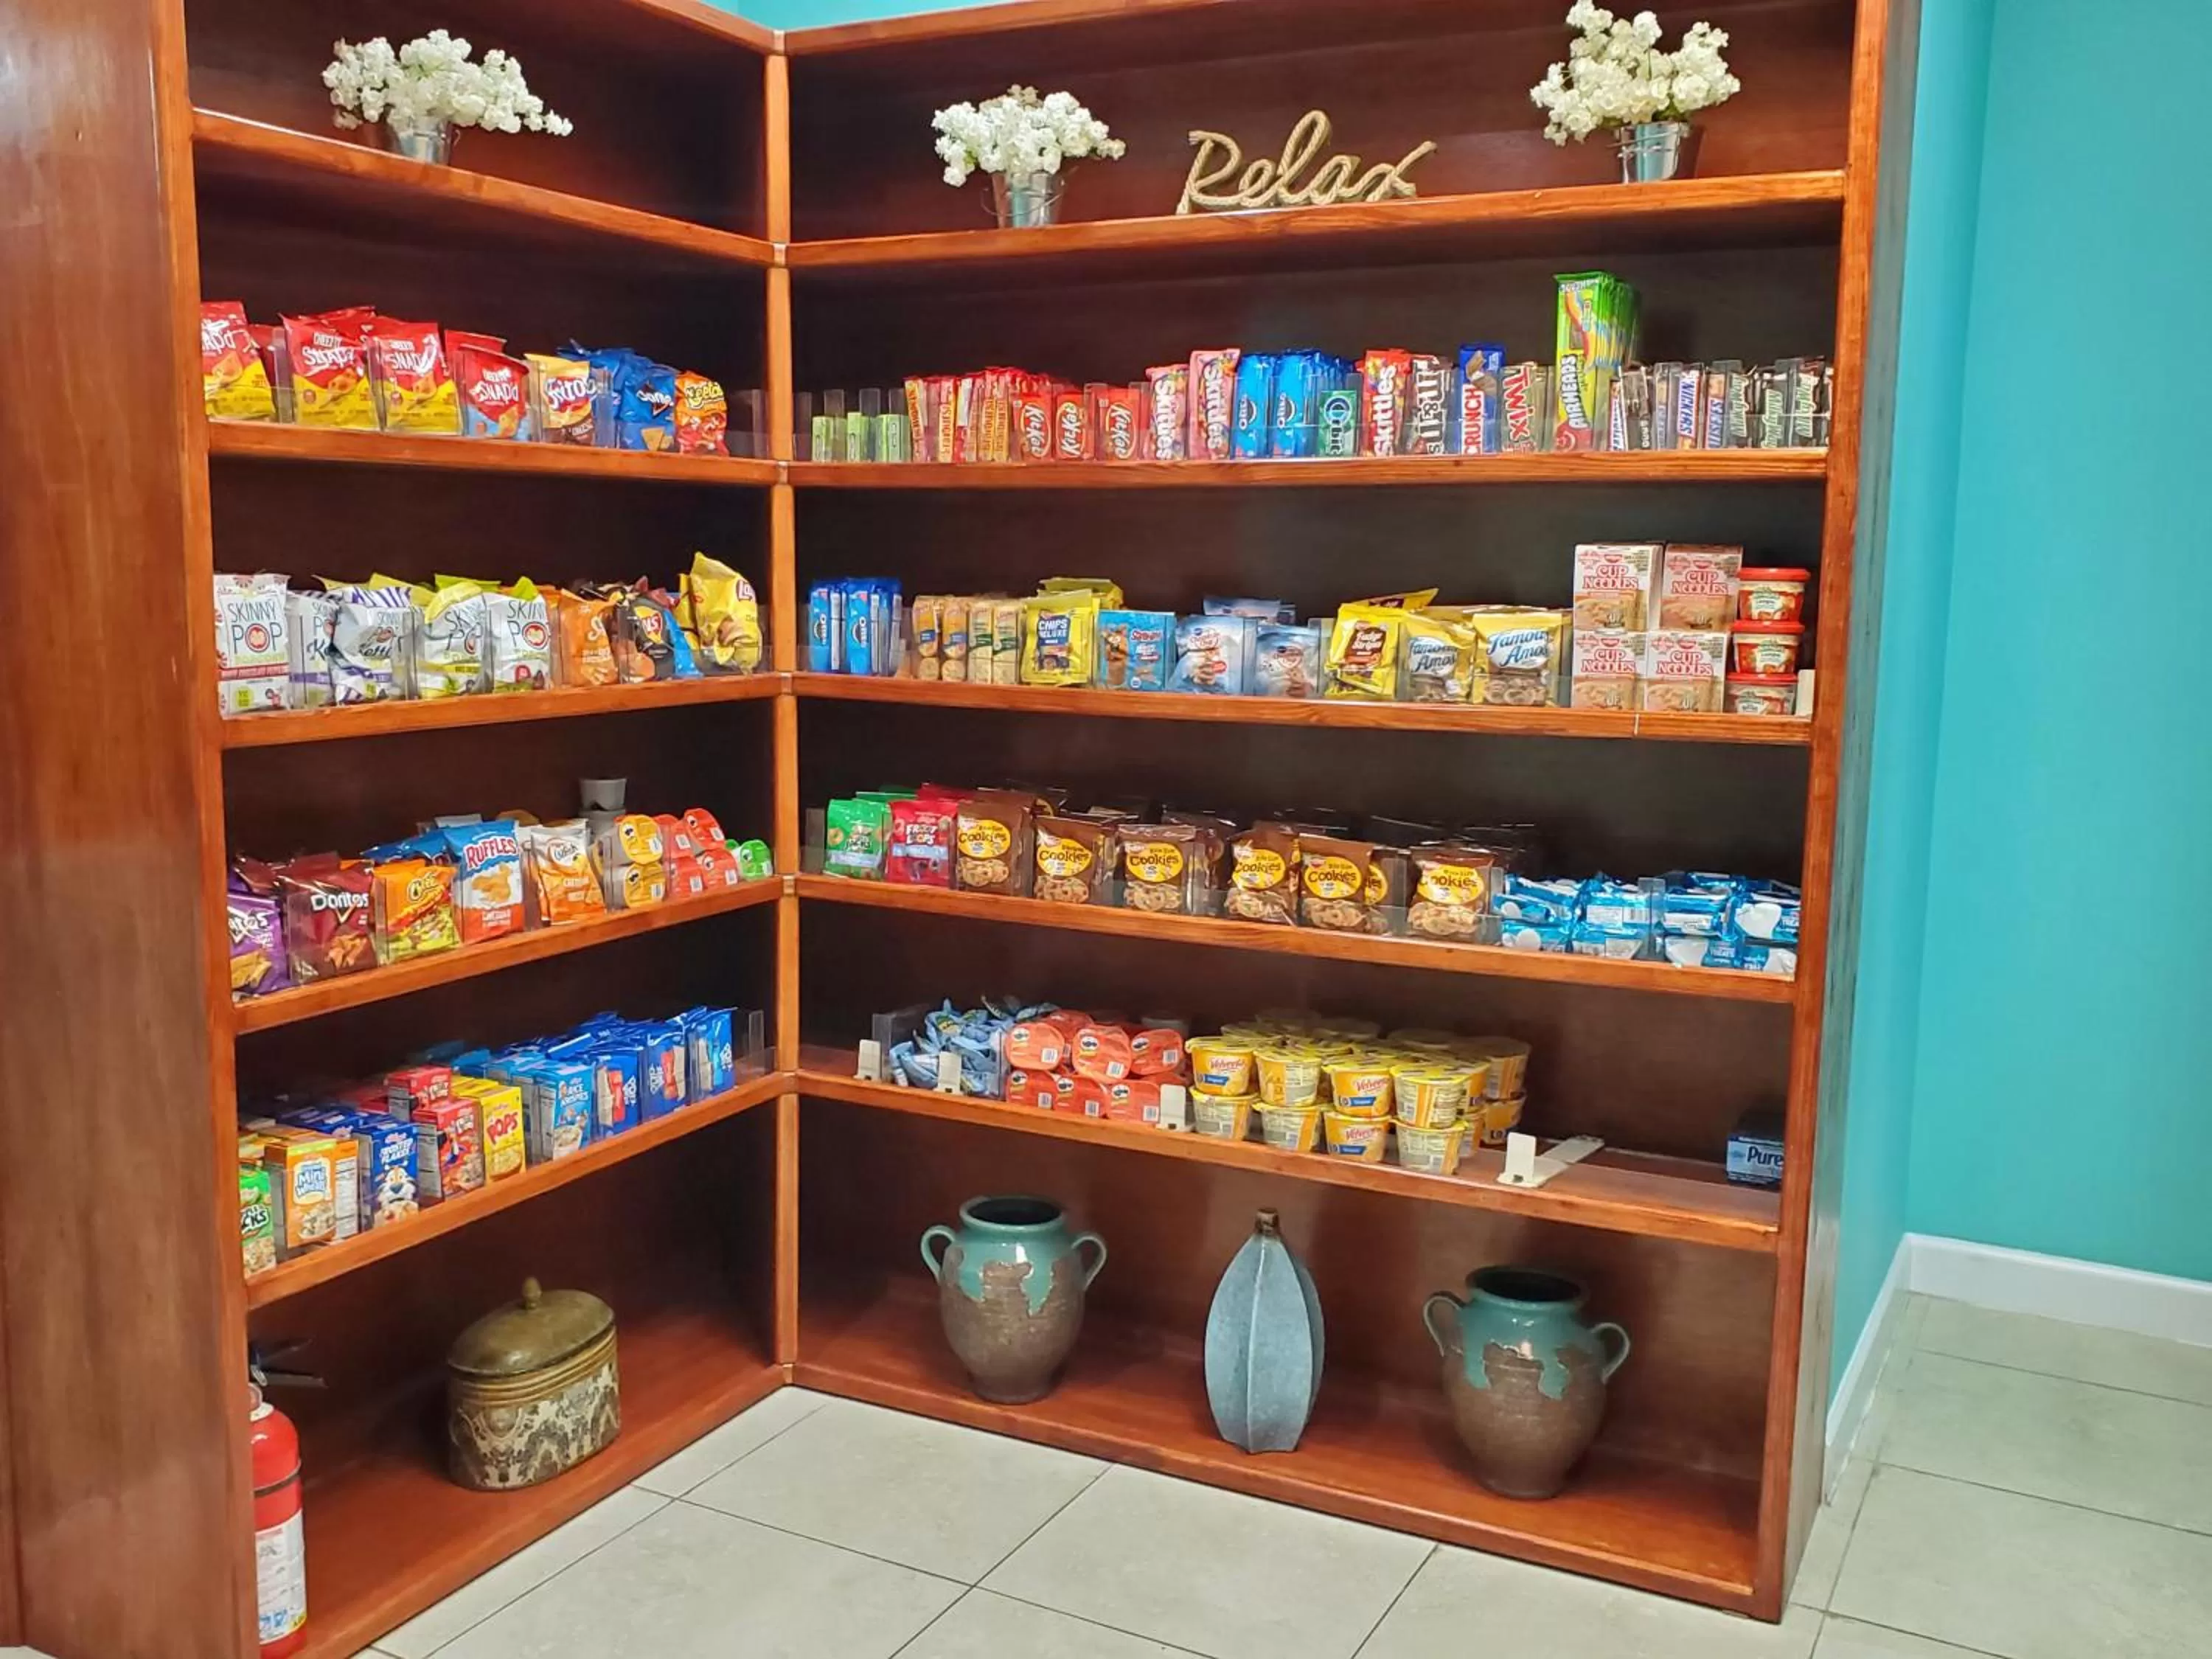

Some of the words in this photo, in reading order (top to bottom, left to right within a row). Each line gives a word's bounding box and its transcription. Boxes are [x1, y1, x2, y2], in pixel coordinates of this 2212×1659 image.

[1176, 110, 1438, 215] Relax
[1561, 354, 1588, 429] AIRHEADS
[1373, 365, 1397, 457] Skittles
[1464, 389, 1484, 455] CRUNCH
[1596, 565, 1629, 577] CUP
[1685, 571, 1719, 582] CUP
[1582, 577, 1638, 589] NOODLES
[1672, 582, 1729, 595] NOODLES
[227, 601, 278, 622] SKINNY
[1038, 619, 1068, 630] CHIPS
[231, 622, 283, 654] POP
[507, 620, 549, 650] PO
[1593, 649, 1627, 661] CUP
[1670, 651, 1703, 663] CUP
[1581, 661, 1635, 672] NOODLES
[1657, 663, 1713, 675] NOODLES
[958, 832, 1007, 846] Cookies
[465, 836, 518, 869] RUFFLES
[1039, 849, 1090, 863] Cookies
[1130, 853, 1180, 867] Cookies
[1234, 861, 1281, 877] Cookies
[1308, 870, 1357, 885] Cookies
[310, 891, 369, 911] Doritos
[487, 1111, 519, 1145] POPS
[1747, 1145, 1784, 1167] Pure
